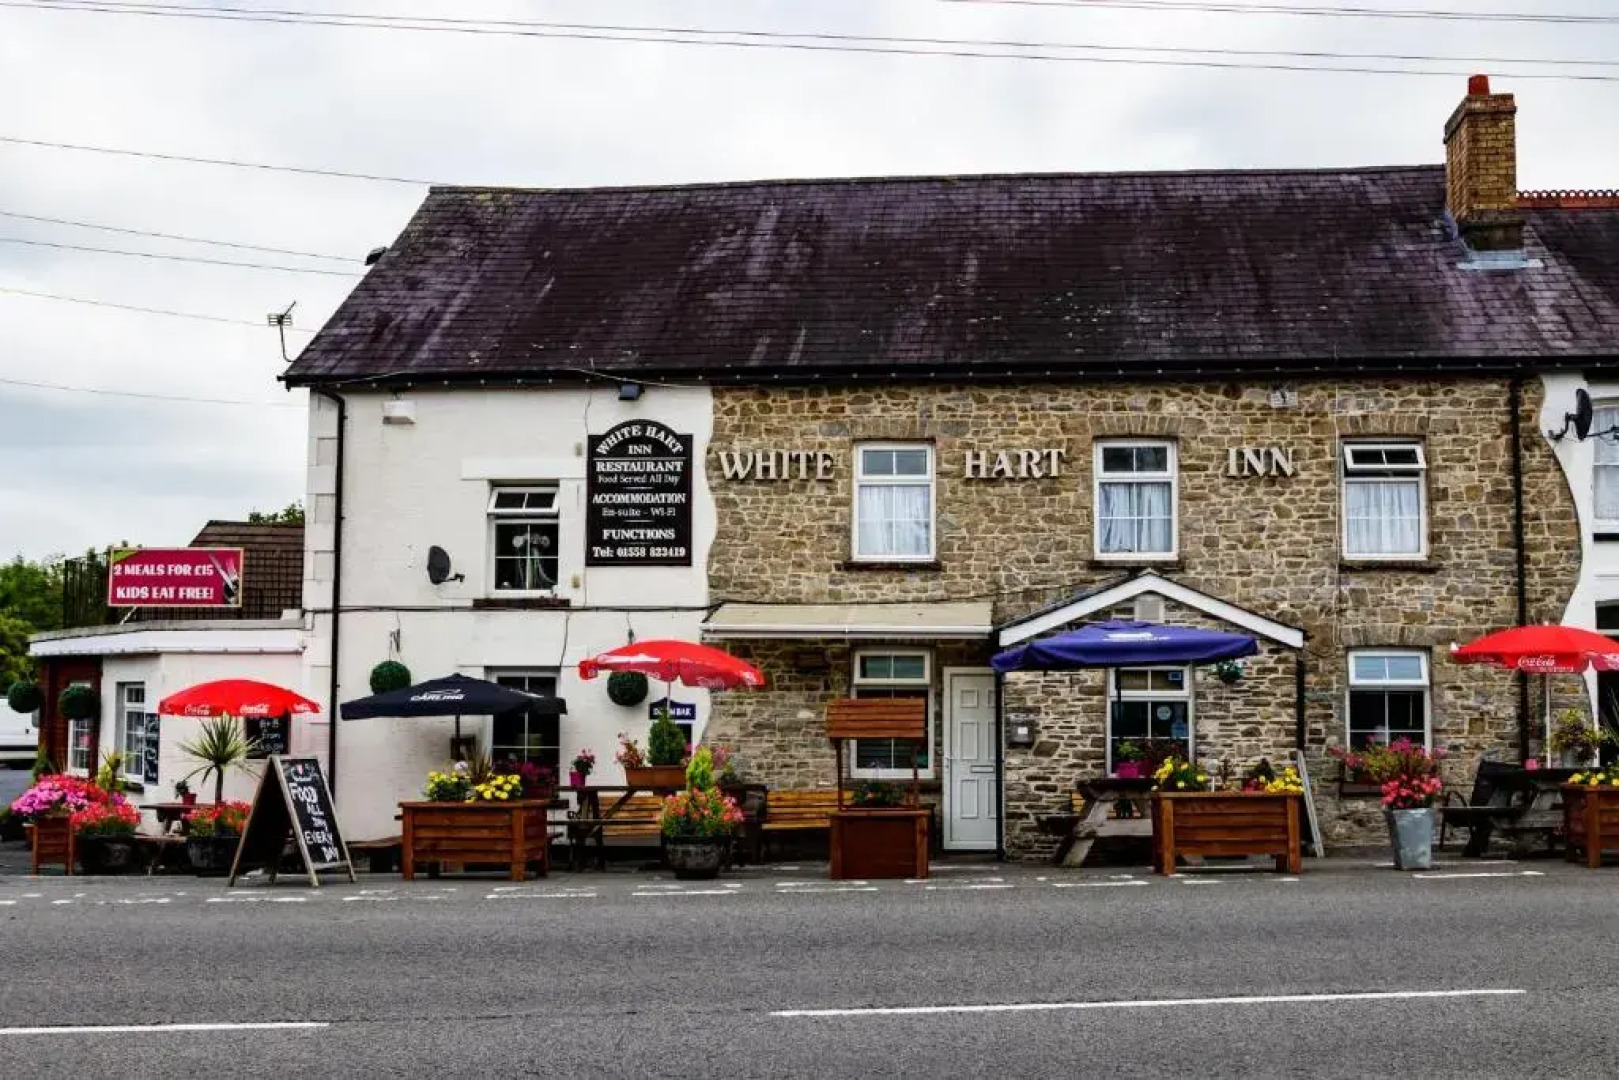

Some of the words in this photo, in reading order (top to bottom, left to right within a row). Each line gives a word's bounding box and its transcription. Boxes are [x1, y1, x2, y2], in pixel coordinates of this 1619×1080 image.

[596, 425, 641, 455] WHITE
[645, 425, 684, 454] HART
[628, 444, 652, 455] INN
[595, 461, 684, 472] RESTAURANT
[718, 451, 835, 480] WHITE
[964, 448, 1066, 479] HART
[1227, 447, 1295, 477] INN
[598, 474, 618, 483] Food
[619, 474, 647, 483] Served
[649, 474, 662, 483] All
[664, 474, 680, 486] Day
[593, 493, 686, 504] ACCOMMODATION
[603, 529, 676, 540] FUNCTIONS
[592, 546, 614, 557] Tel:
[113, 564, 122, 576] 2
[124, 564, 165, 576] MEALS
[167, 564, 192, 576] FOR
[194, 564, 214, 576] £15
[116, 586, 149, 599] KIDS
[151, 586, 176, 599] EAT
[178, 586, 214, 600] FREE!
[676, 707, 692, 716] BAR
[289, 782, 318, 803] FOOD
[304, 831, 334, 846] EVERY
